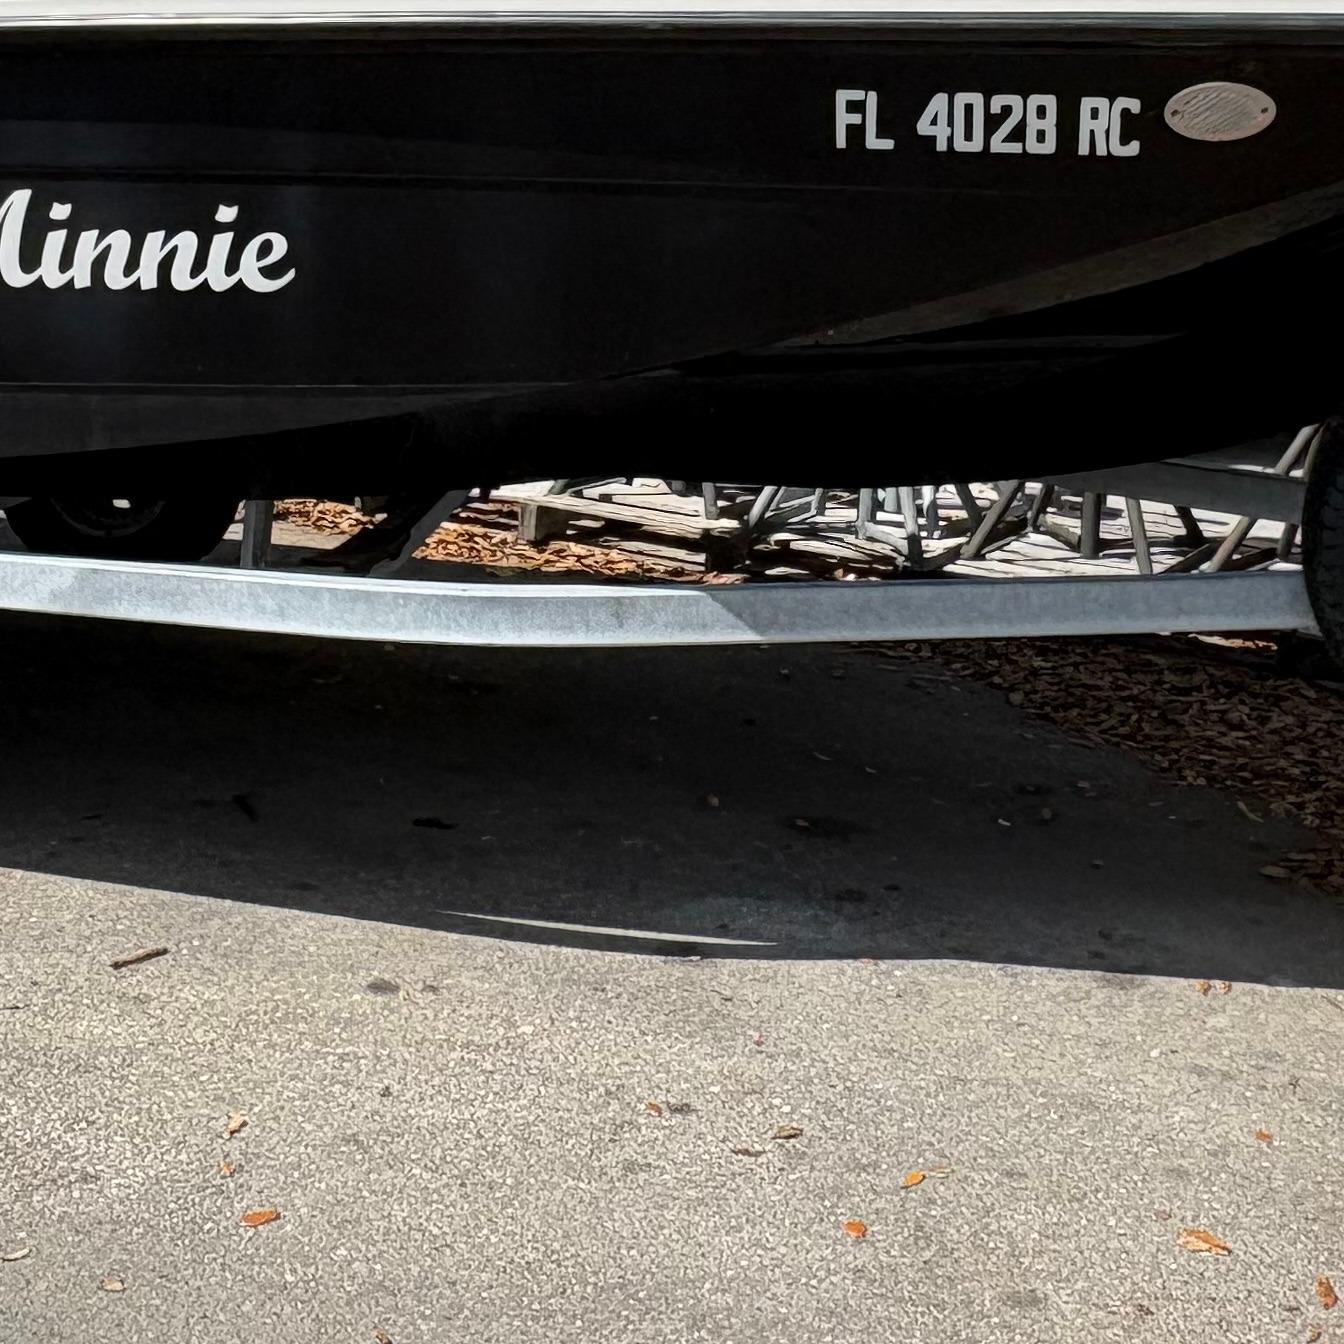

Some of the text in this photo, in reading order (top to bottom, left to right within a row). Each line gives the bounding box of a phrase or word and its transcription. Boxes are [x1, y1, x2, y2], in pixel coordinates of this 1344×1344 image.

[835, 89, 1141, 157] FL 4028 RC
